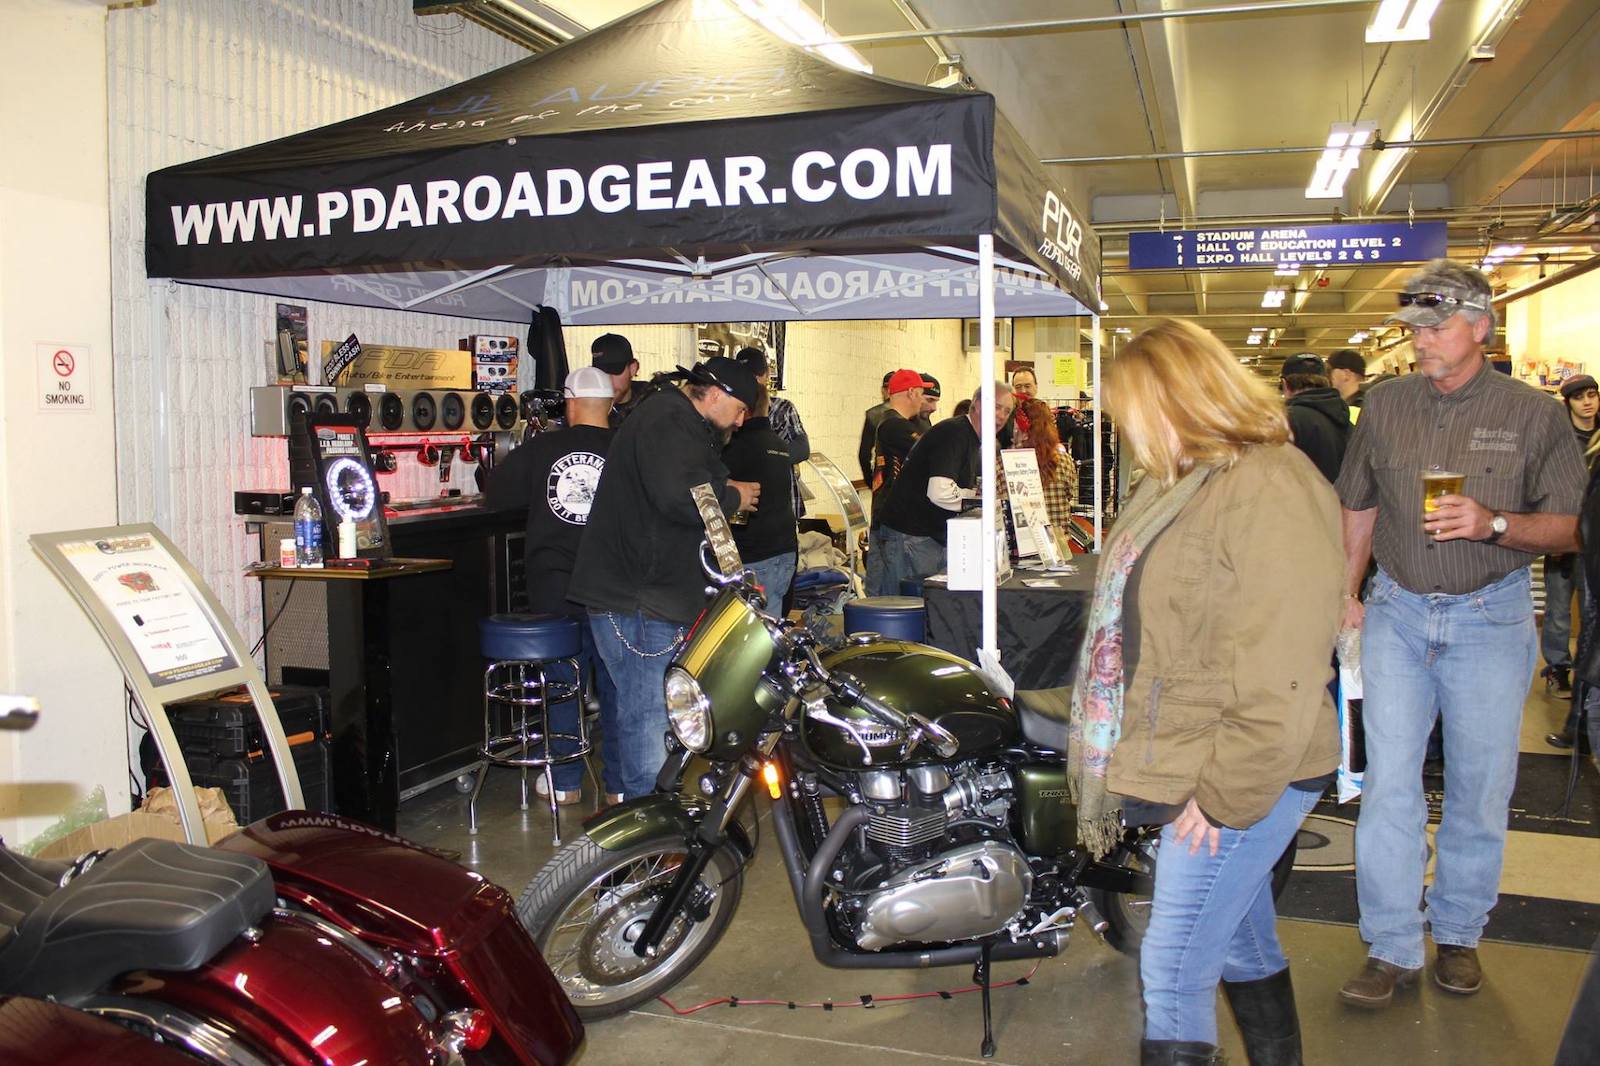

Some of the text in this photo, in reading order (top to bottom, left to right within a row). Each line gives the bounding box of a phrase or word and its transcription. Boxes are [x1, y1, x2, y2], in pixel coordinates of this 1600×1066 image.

[171, 143, 952, 246] WWW.PDAROADGEAR.COM
[1042, 190, 1082, 264] PDA
[1196, 229, 1307, 242] STADIUM ARENA
[1196, 237, 1401, 253] HALL OF EDUCATION LEVEL 2
[1196, 250, 1380, 264] EXPO HALL LEVELS 2 & 3
[334, 342, 351, 361] BLESS
[343, 345, 361, 362] CASH
[356, 349, 447, 370] PDA
[58, 381, 71, 391] NO
[45, 394, 84, 405] SMOKING
[550, 454, 605, 476] VETERAN
[549, 496, 562, 511] DO
[560, 509, 573, 519] IT
[574, 514, 588, 522] BE
